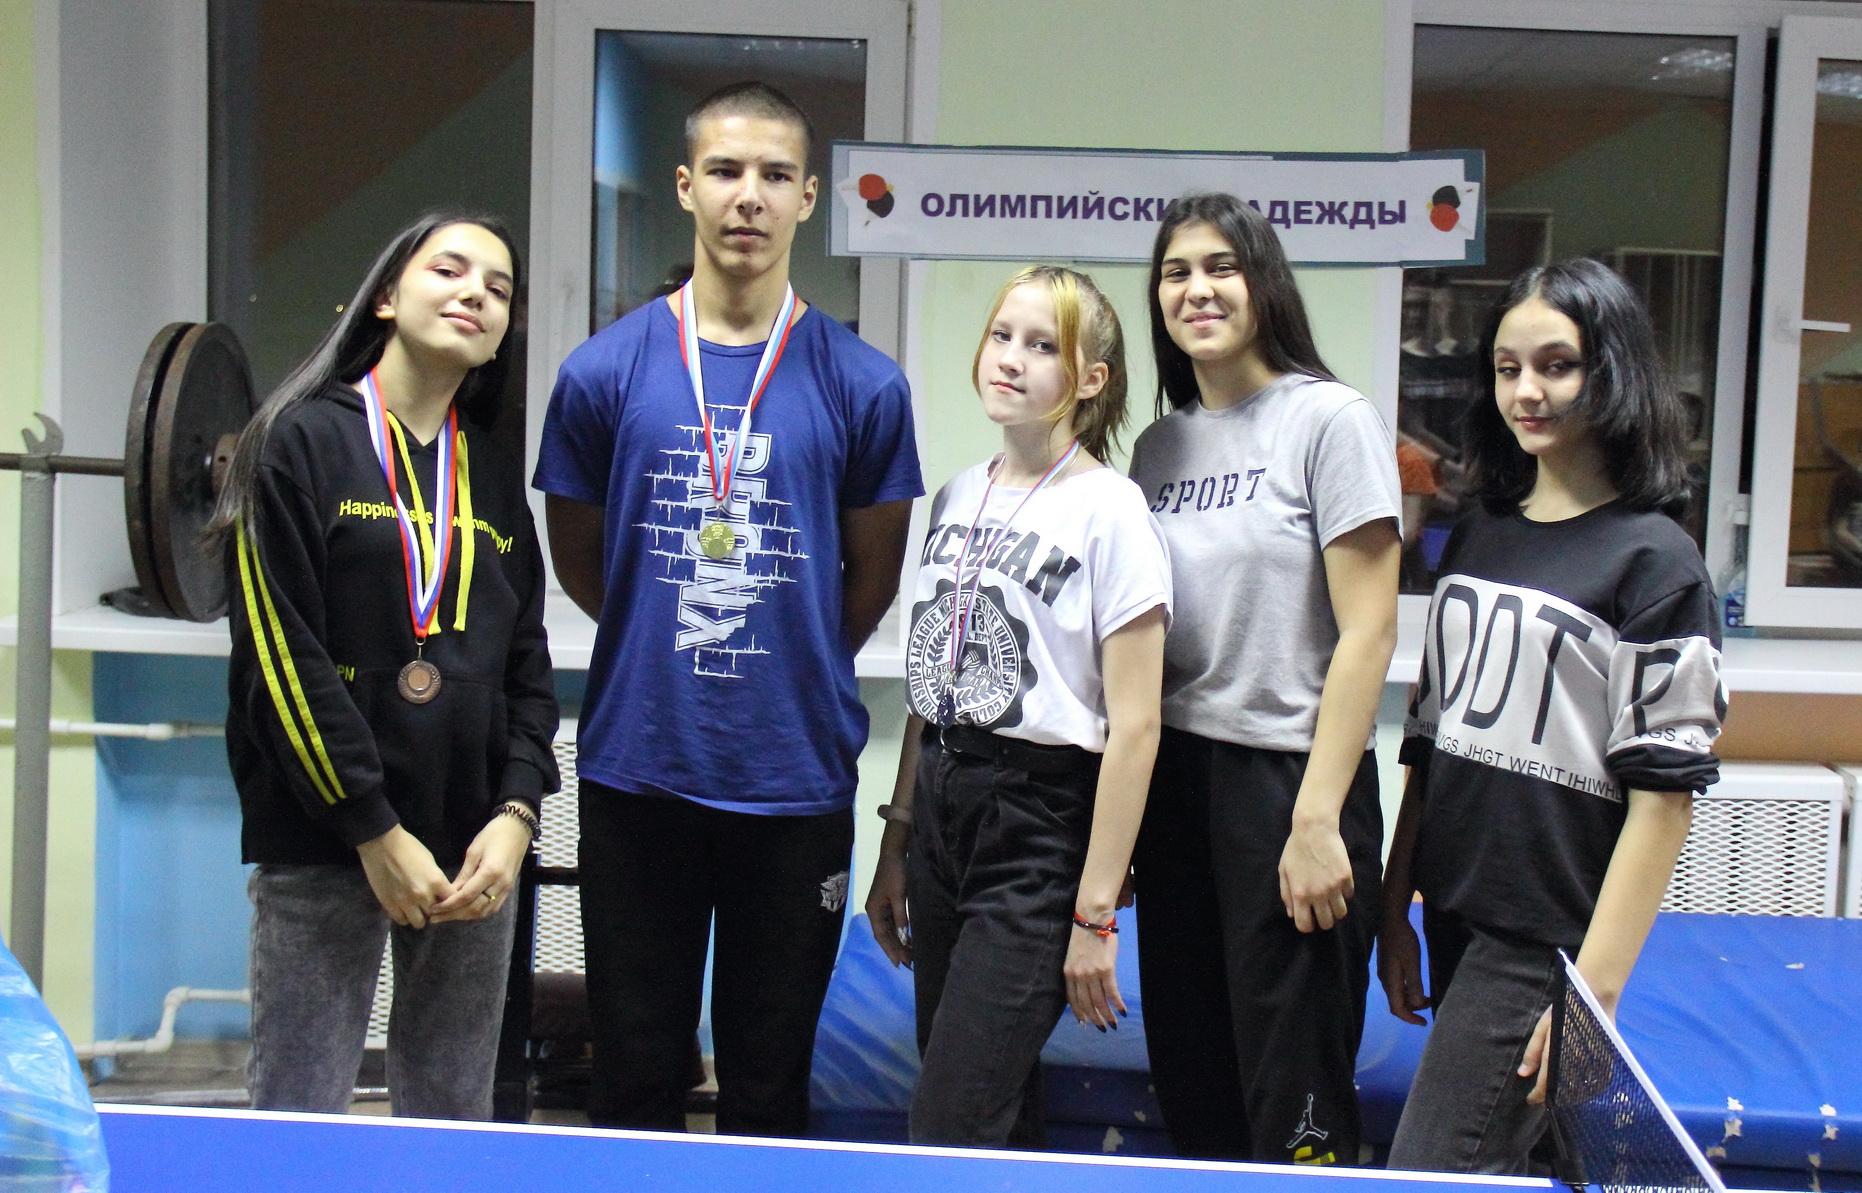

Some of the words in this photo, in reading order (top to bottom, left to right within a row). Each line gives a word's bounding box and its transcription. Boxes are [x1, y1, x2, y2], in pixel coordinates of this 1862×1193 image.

[919, 191, 1179, 223] ОЛИМПИЙСКИ
[1248, 199, 1408, 229] ДЕЖДЫ
[339, 499, 417, 520] Happins
[1150, 467, 1267, 514] SPORT
[922, 523, 1082, 607] ICHGAN
[911, 612, 941, 658] LEAGUE
[925, 663, 952, 678] LEAGU
[1463, 743, 1504, 767] JHGT
[1509, 755, 1566, 783] WENT
